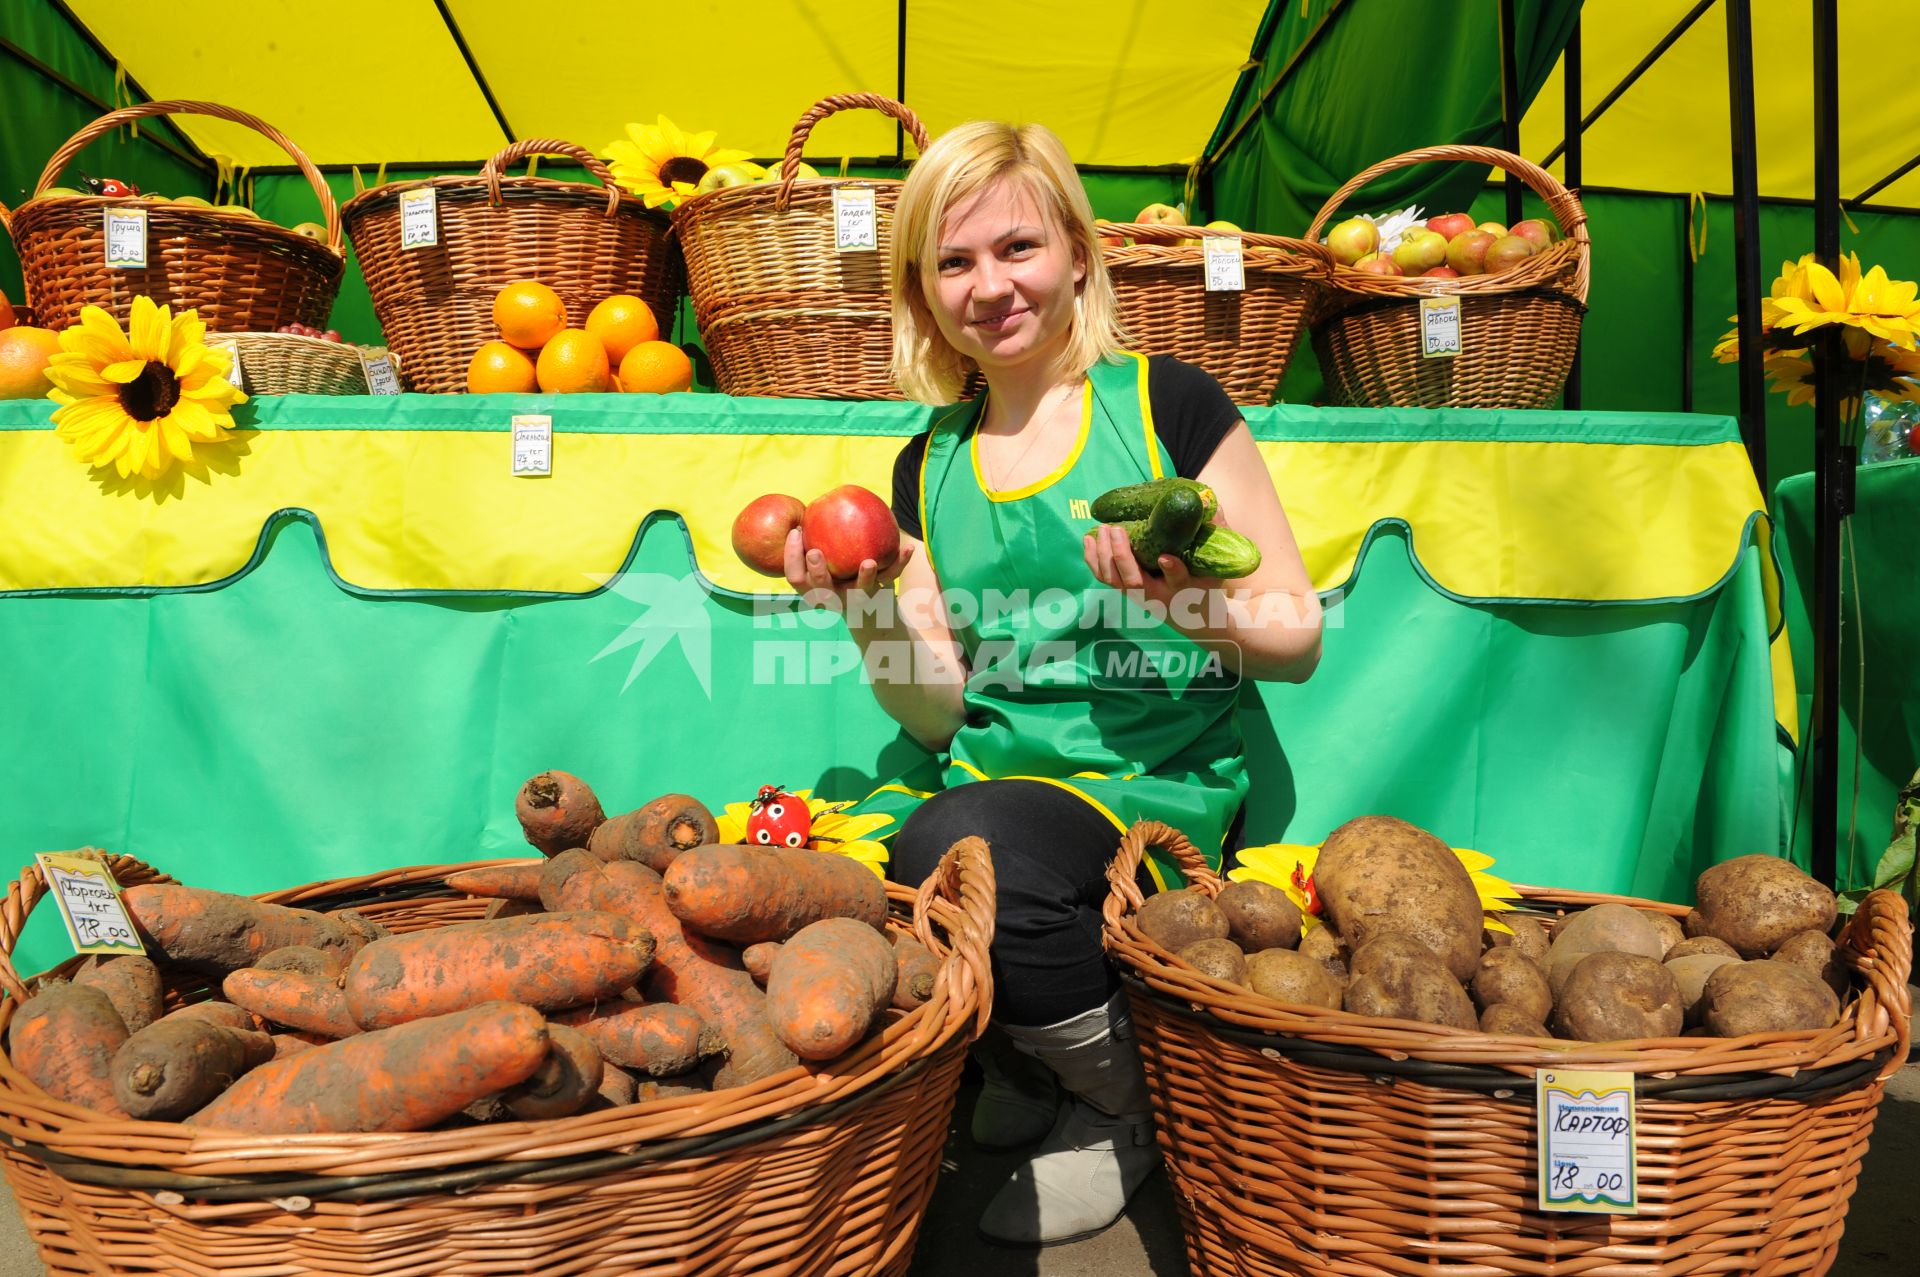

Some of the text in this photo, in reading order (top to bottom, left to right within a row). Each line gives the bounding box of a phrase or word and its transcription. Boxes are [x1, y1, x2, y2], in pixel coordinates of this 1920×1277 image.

[112, 223, 141, 235] Груша
[79, 917, 130, 939] 18 00
[1552, 1166, 1580, 1190] 18
[1597, 1173, 1623, 1190] 00
